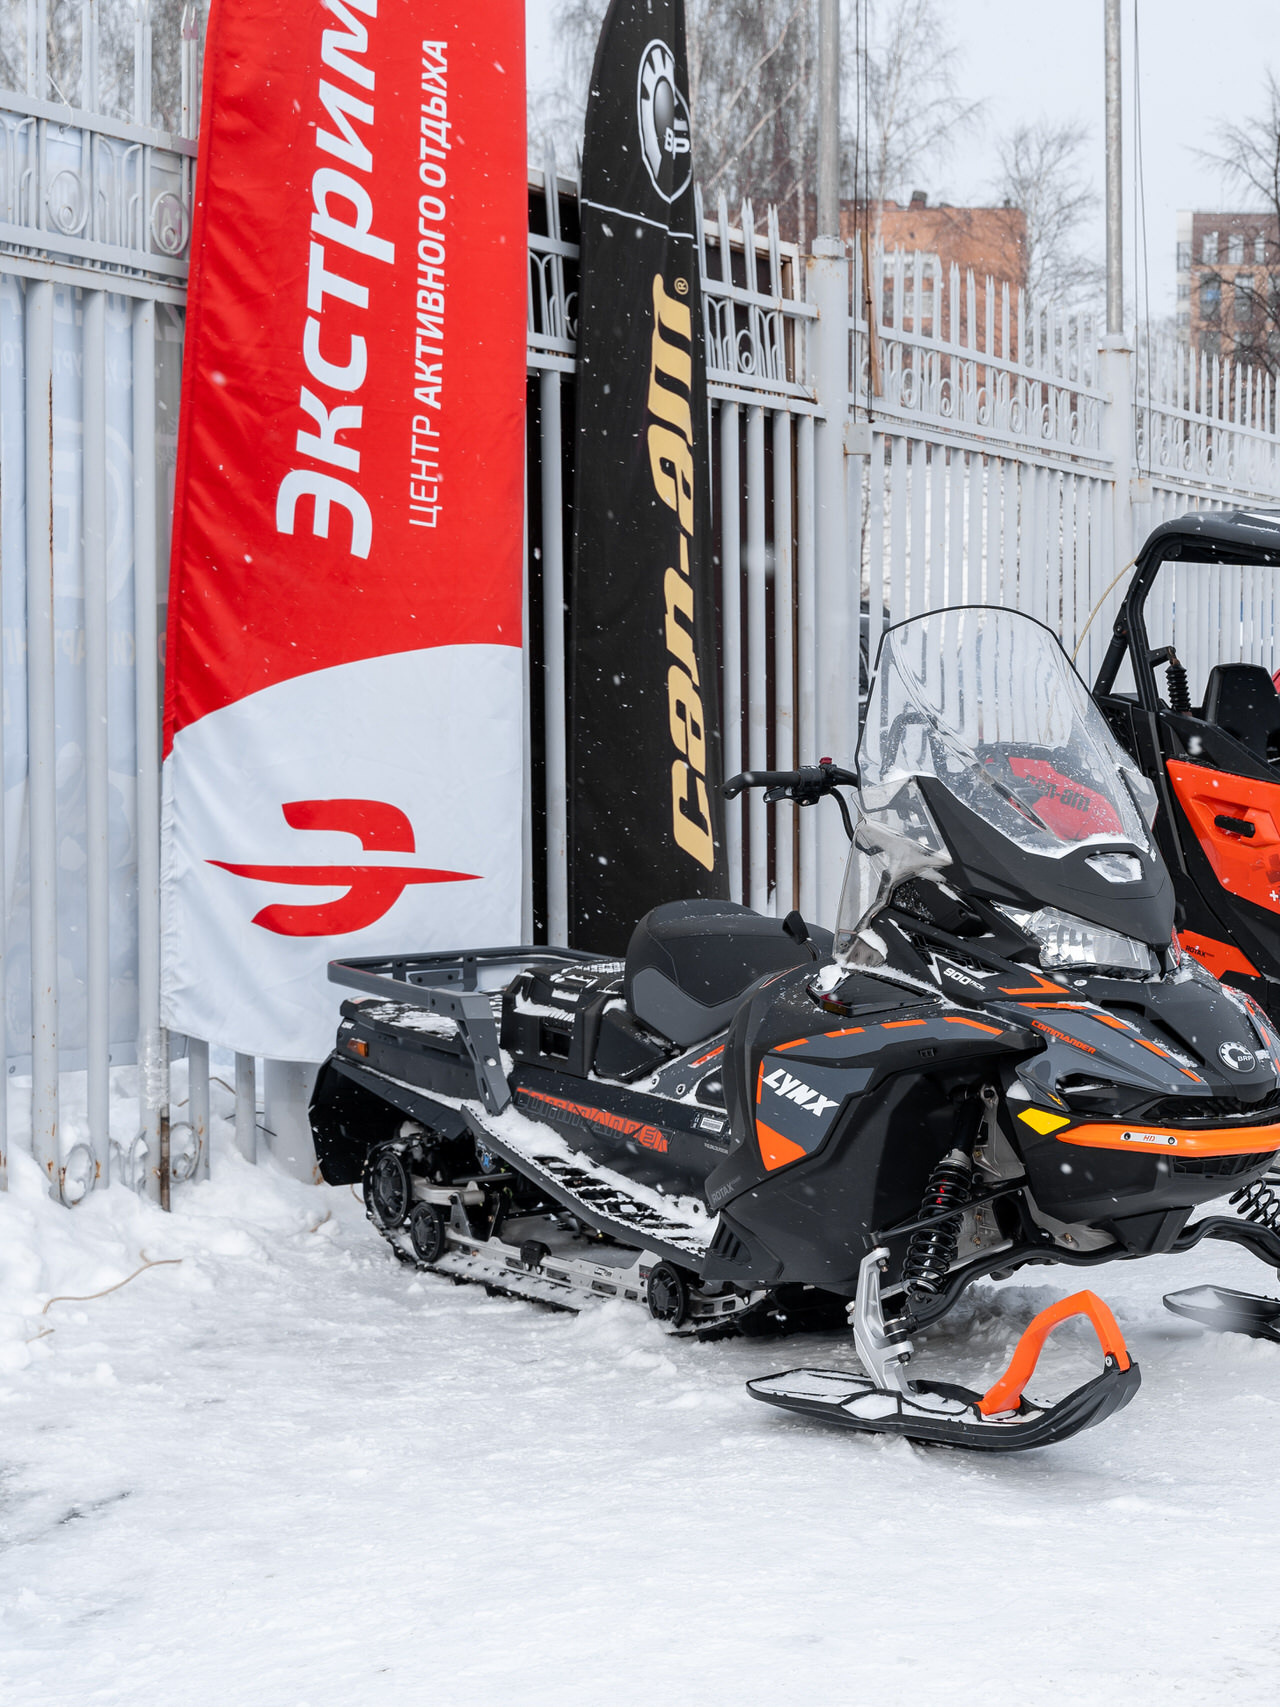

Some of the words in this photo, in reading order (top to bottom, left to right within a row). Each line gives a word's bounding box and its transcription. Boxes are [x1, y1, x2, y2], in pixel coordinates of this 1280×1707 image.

[419, 40, 452, 188] ОТДЫХА
[276, 0, 395, 560] Экстрим
[414, 195, 447, 410] АКТИВНОГО
[409, 415, 443, 528] ЦЕНТР
[1031, 1019, 1097, 1055] COMMANDER
[1237, 1055, 1253, 1063] BRP
[513, 1086, 676, 1154] COMMANDER
[762, 1067, 841, 1117] LYNX
[1143, 1134, 1156, 1143] HD
